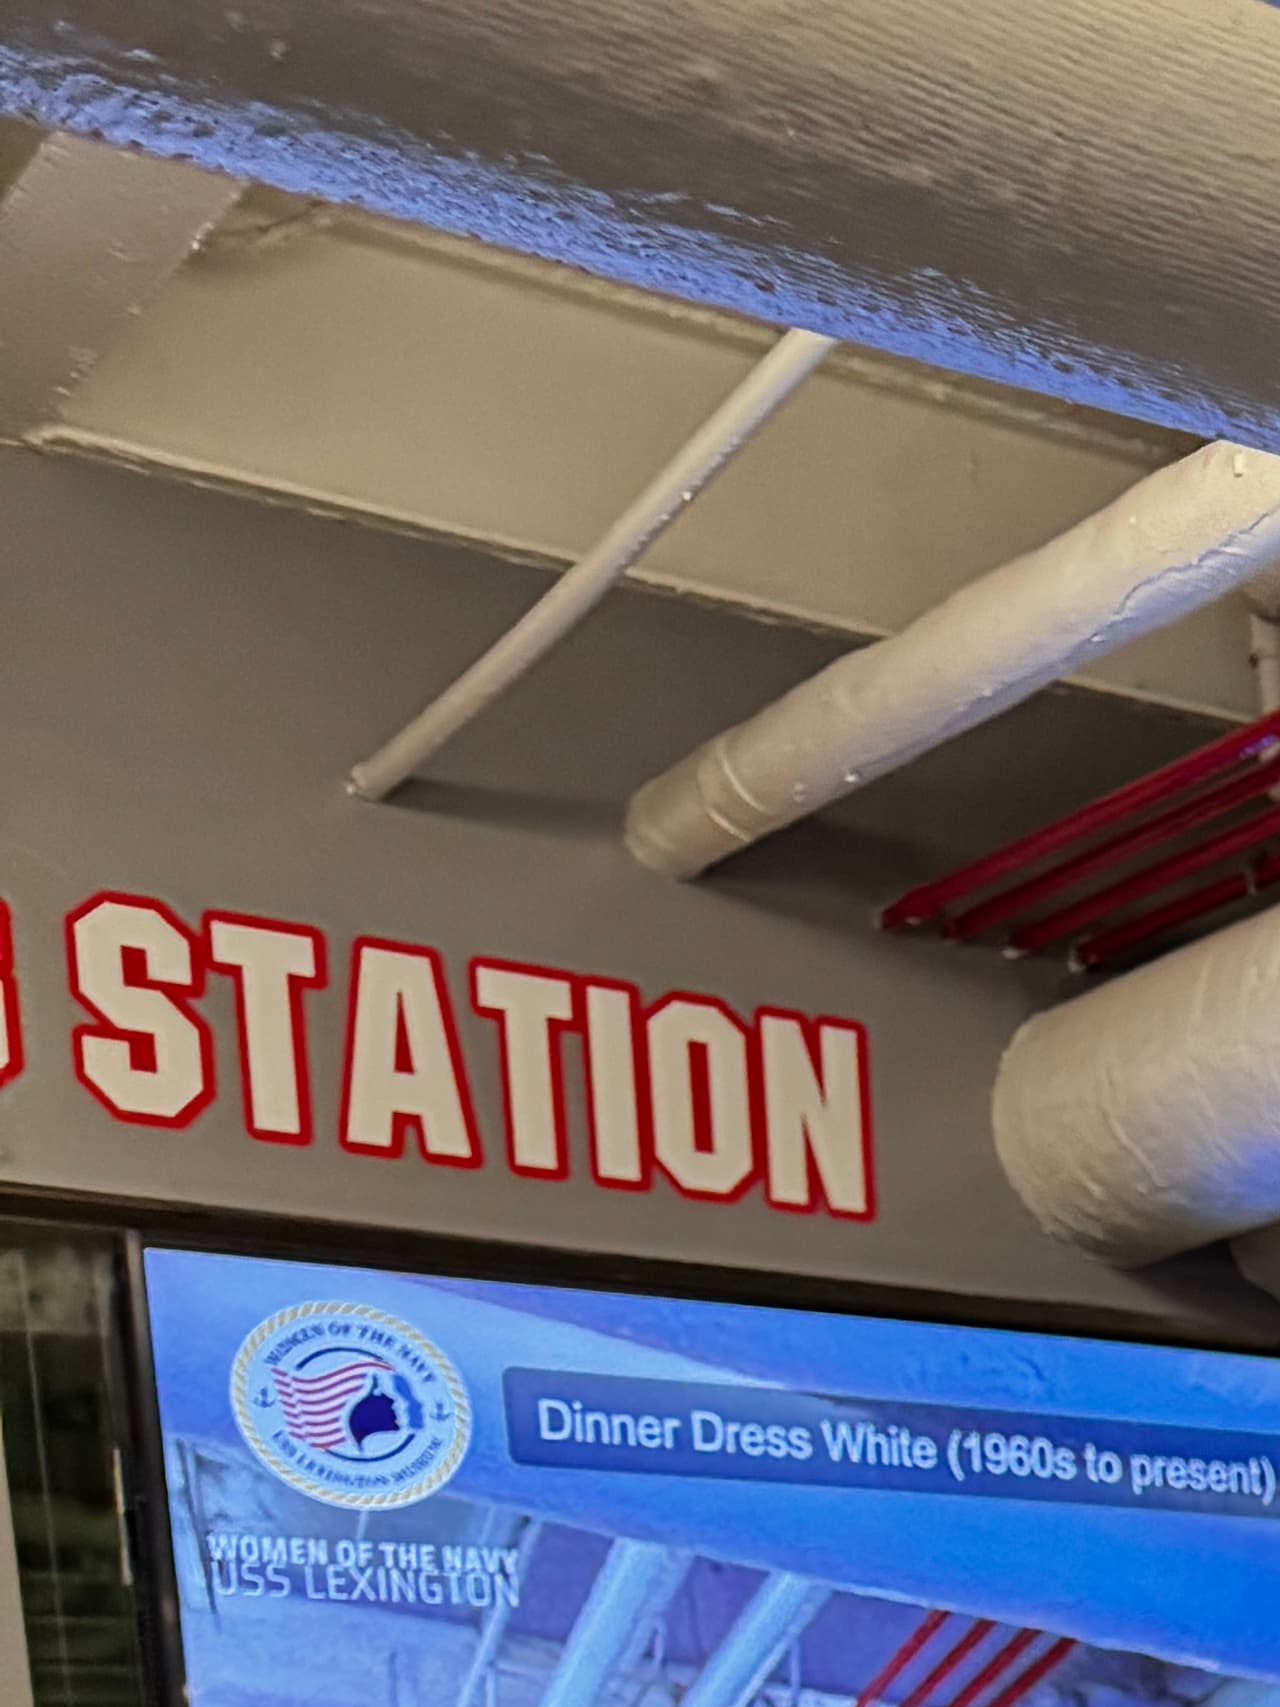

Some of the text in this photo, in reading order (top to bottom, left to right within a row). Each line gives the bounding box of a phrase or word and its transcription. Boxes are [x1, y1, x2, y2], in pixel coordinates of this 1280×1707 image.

[66, 890, 876, 1221] STATION
[537, 1397, 1277, 1507] Dinner Dress White (1960s to present)
[206, 1533, 520, 1576] WOMEN OF THE NAVY
[210, 1558, 521, 1609] USS LEXINGTON
